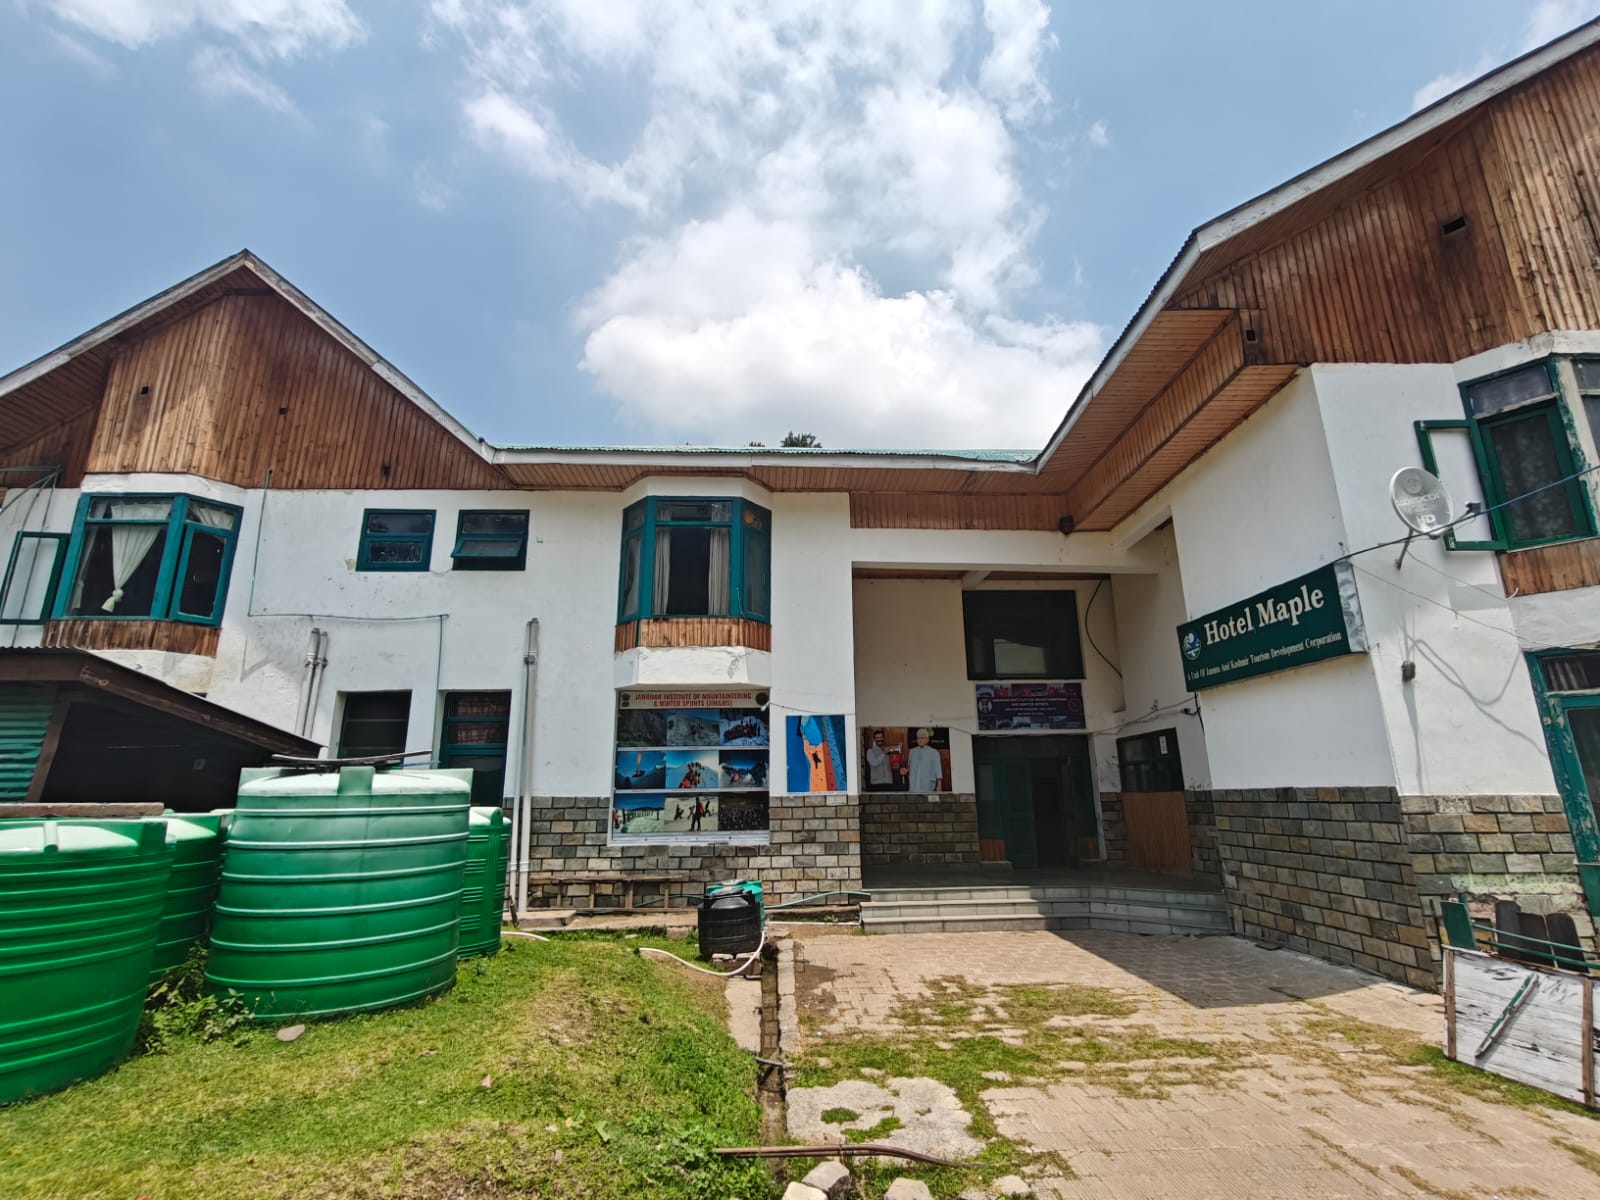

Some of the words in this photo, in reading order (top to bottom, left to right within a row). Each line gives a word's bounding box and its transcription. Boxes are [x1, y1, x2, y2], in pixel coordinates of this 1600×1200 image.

[1203, 607, 1255, 646] Hotel
[1256, 584, 1325, 626] Maple
[1230, 658, 1249, 669] Kashmir
[1250, 652, 1270, 665] Tourism
[1270, 642, 1304, 657] Development
[1305, 631, 1342, 649] Corporation
